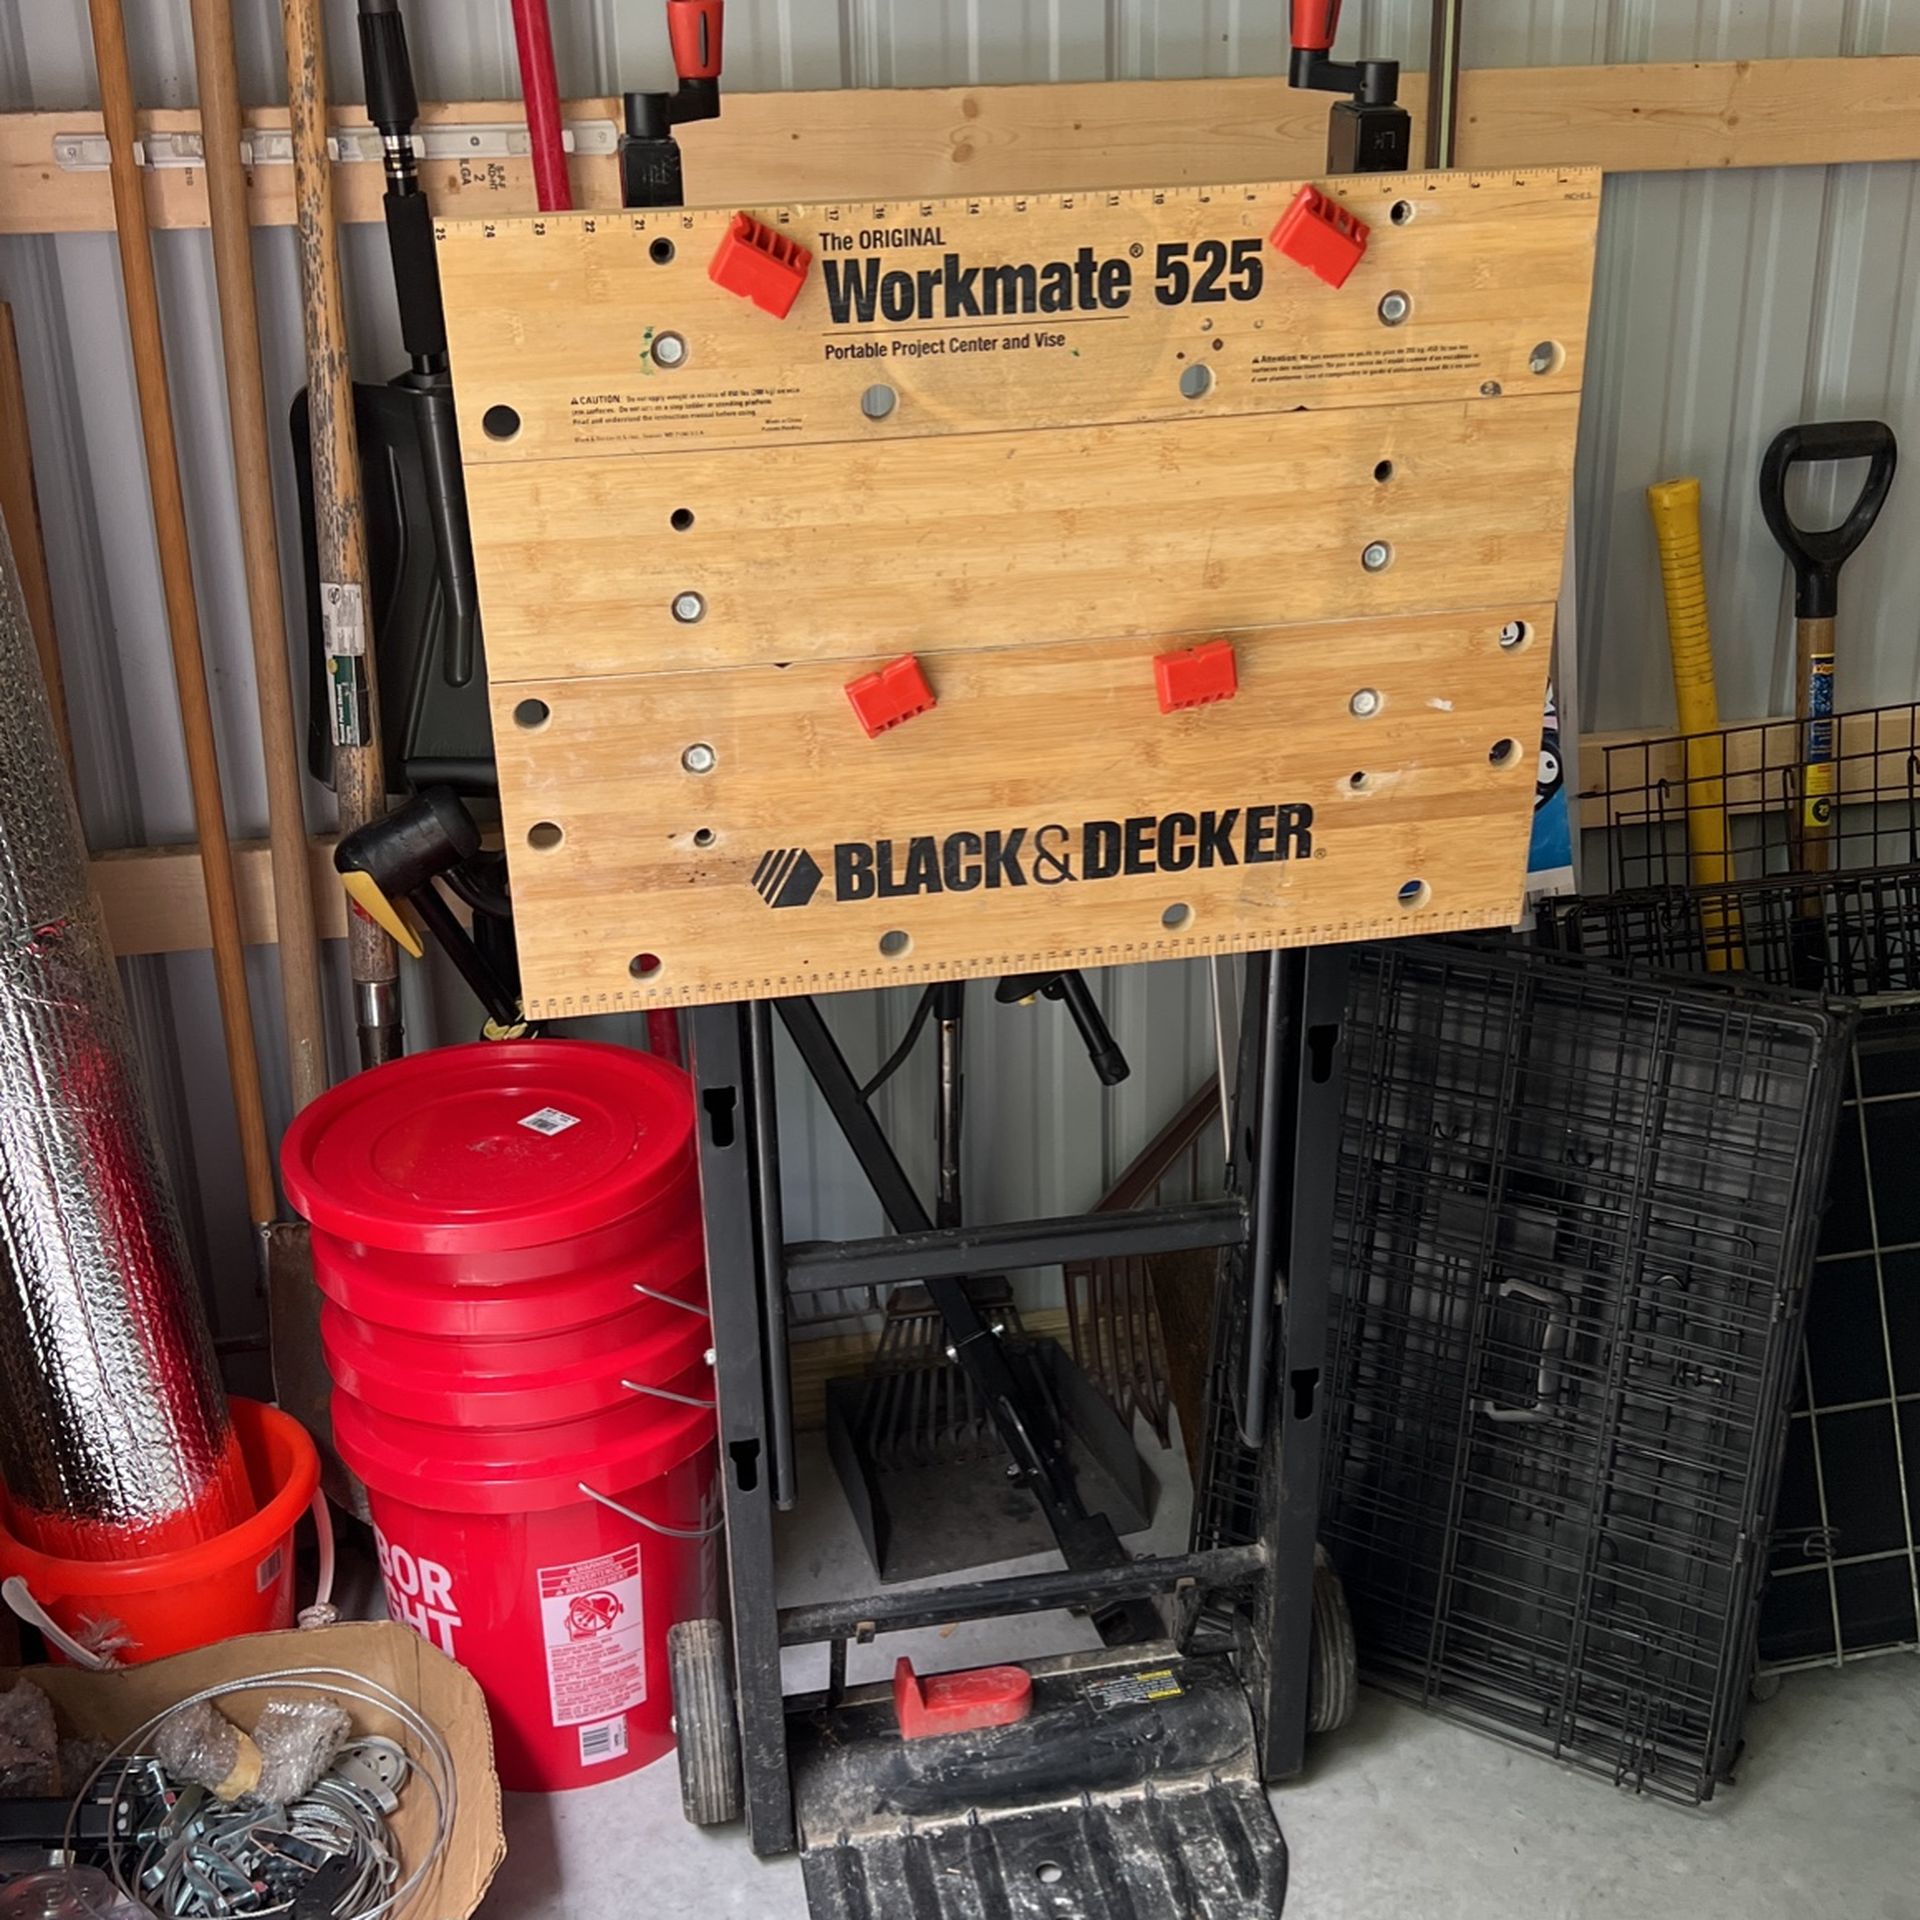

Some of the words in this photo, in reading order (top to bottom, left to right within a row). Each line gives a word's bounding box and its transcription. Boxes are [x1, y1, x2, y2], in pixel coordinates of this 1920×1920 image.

[436, 227, 446, 241] 25
[485, 224, 495, 238] 24
[535, 222, 546, 236] 23
[585, 220, 596, 233] 22
[634, 218, 644, 231] 21
[684, 216, 694, 230] 20
[782, 212, 790, 223] 18
[830, 210, 839, 221] 17
[876, 208, 885, 219] 16
[924, 206, 932, 217] 15
[970, 203, 979, 214] 14
[1017, 201, 1026, 212] 13
[1064, 199, 1073, 209] 12
[1109, 196, 1119, 206] 11
[1155, 193, 1164, 204] 10
[820, 232, 854, 252] The
[859, 226, 946, 250] ORIGINAL
[1154, 239, 1264, 306] 525
[824, 342, 888, 361] Portable
[892, 339, 946, 359] Project
[949, 335, 998, 354] Center
[1002, 334, 1029, 351] and
[1034, 331, 1066, 349] Vise
